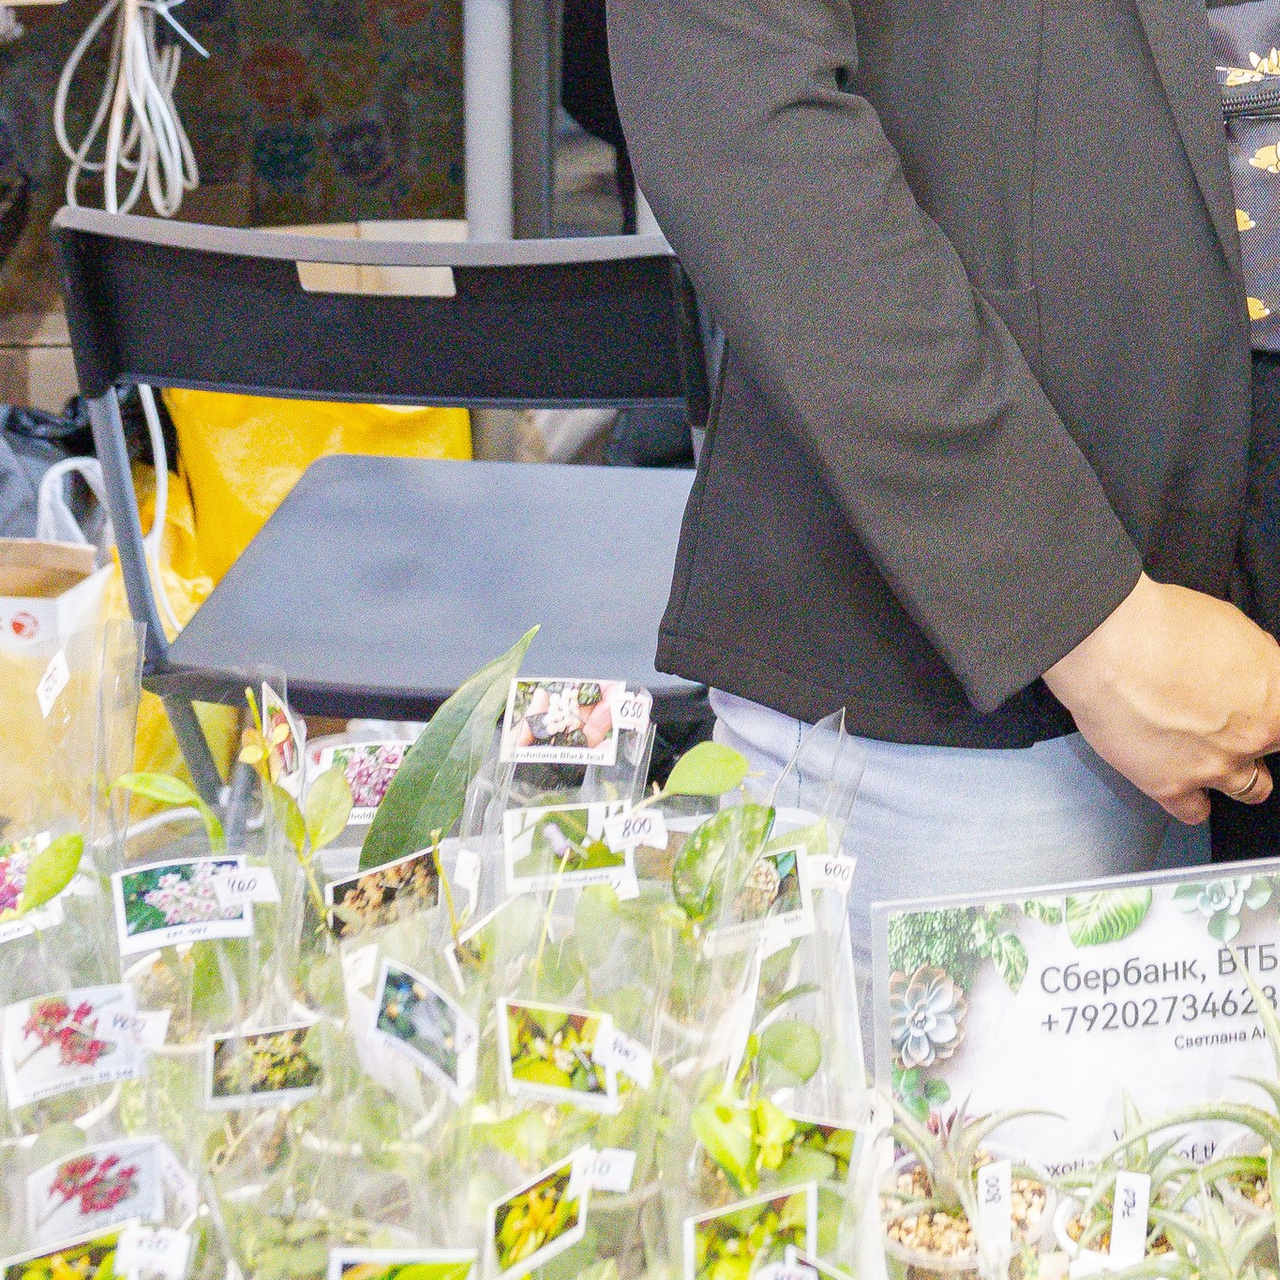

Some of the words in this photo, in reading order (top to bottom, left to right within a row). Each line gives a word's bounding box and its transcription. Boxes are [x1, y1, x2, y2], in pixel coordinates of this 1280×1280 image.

[824, 861, 851, 882] 600
[1039, 956, 1207, 996] Сбербанк,
[1217, 942, 1279, 976] ВТБ
[1173, 1030, 1247, 1050] Светлана
